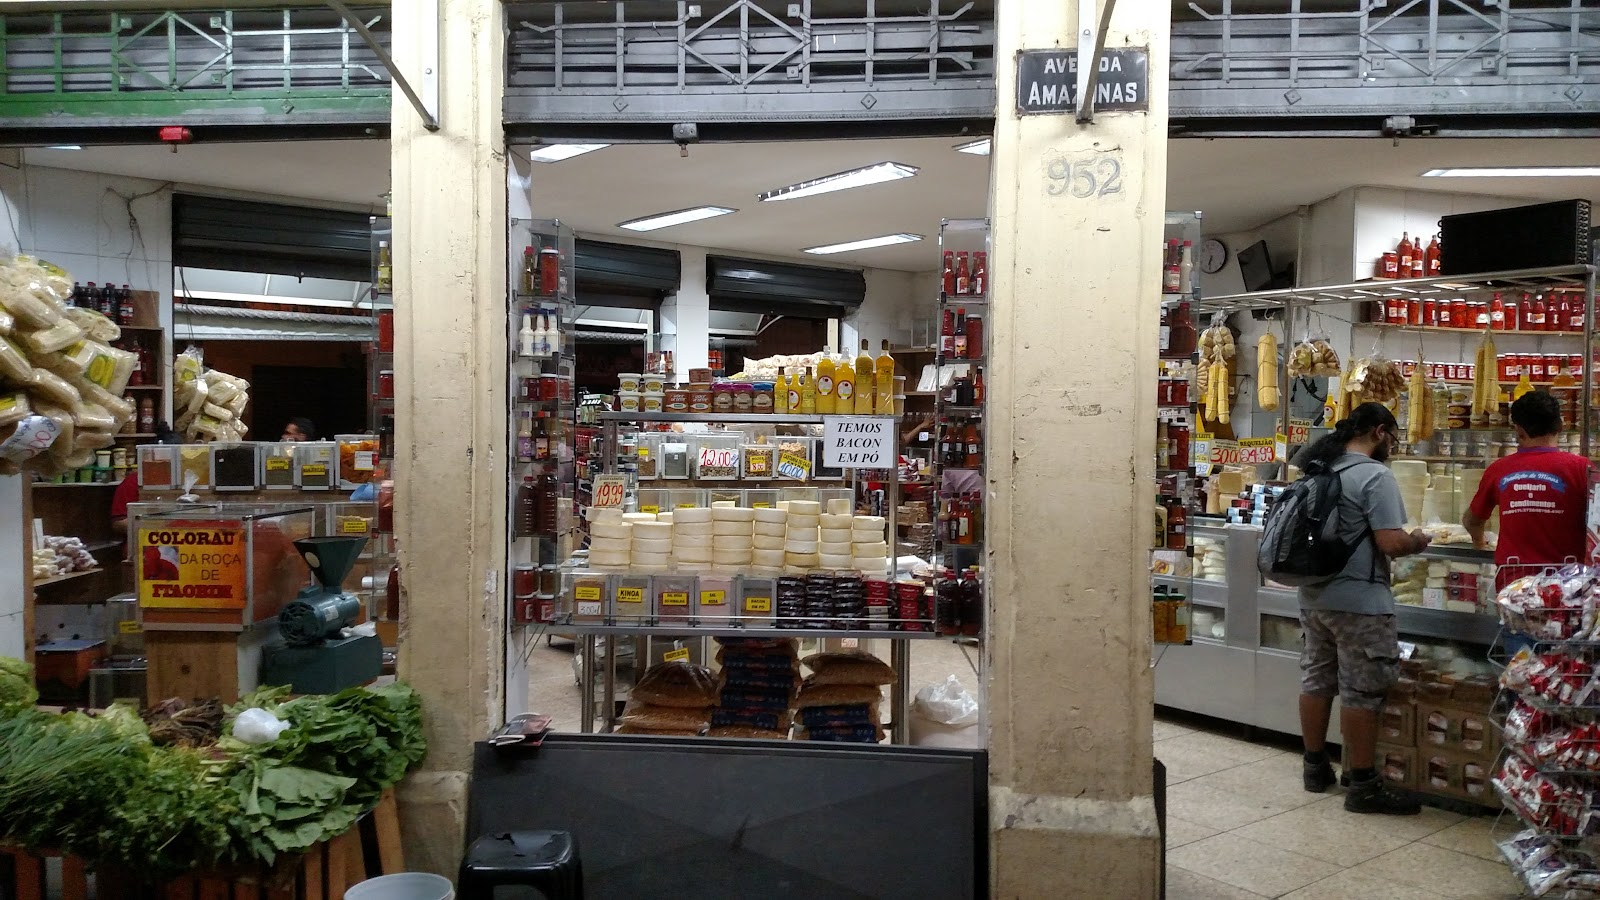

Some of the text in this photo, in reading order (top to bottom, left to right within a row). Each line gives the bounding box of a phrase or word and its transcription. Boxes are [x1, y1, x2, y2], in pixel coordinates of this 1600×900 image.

[1044, 57, 1121, 73] AVEDA
[1028, 82, 1137, 105] AMAZNAS
[1047, 157, 1121, 198] 952
[837, 423, 882, 433] TEMOS
[836, 438, 882, 448] BACON
[838, 450, 879, 463] EM PÓ
[1510, 500, 1556, 508] Condimentos
[148, 531, 235, 545] COLORAU
[180, 553, 241, 568] DA ROÇA
[201, 569, 219, 580] DE
[620, 589, 640, 597] KINOA
